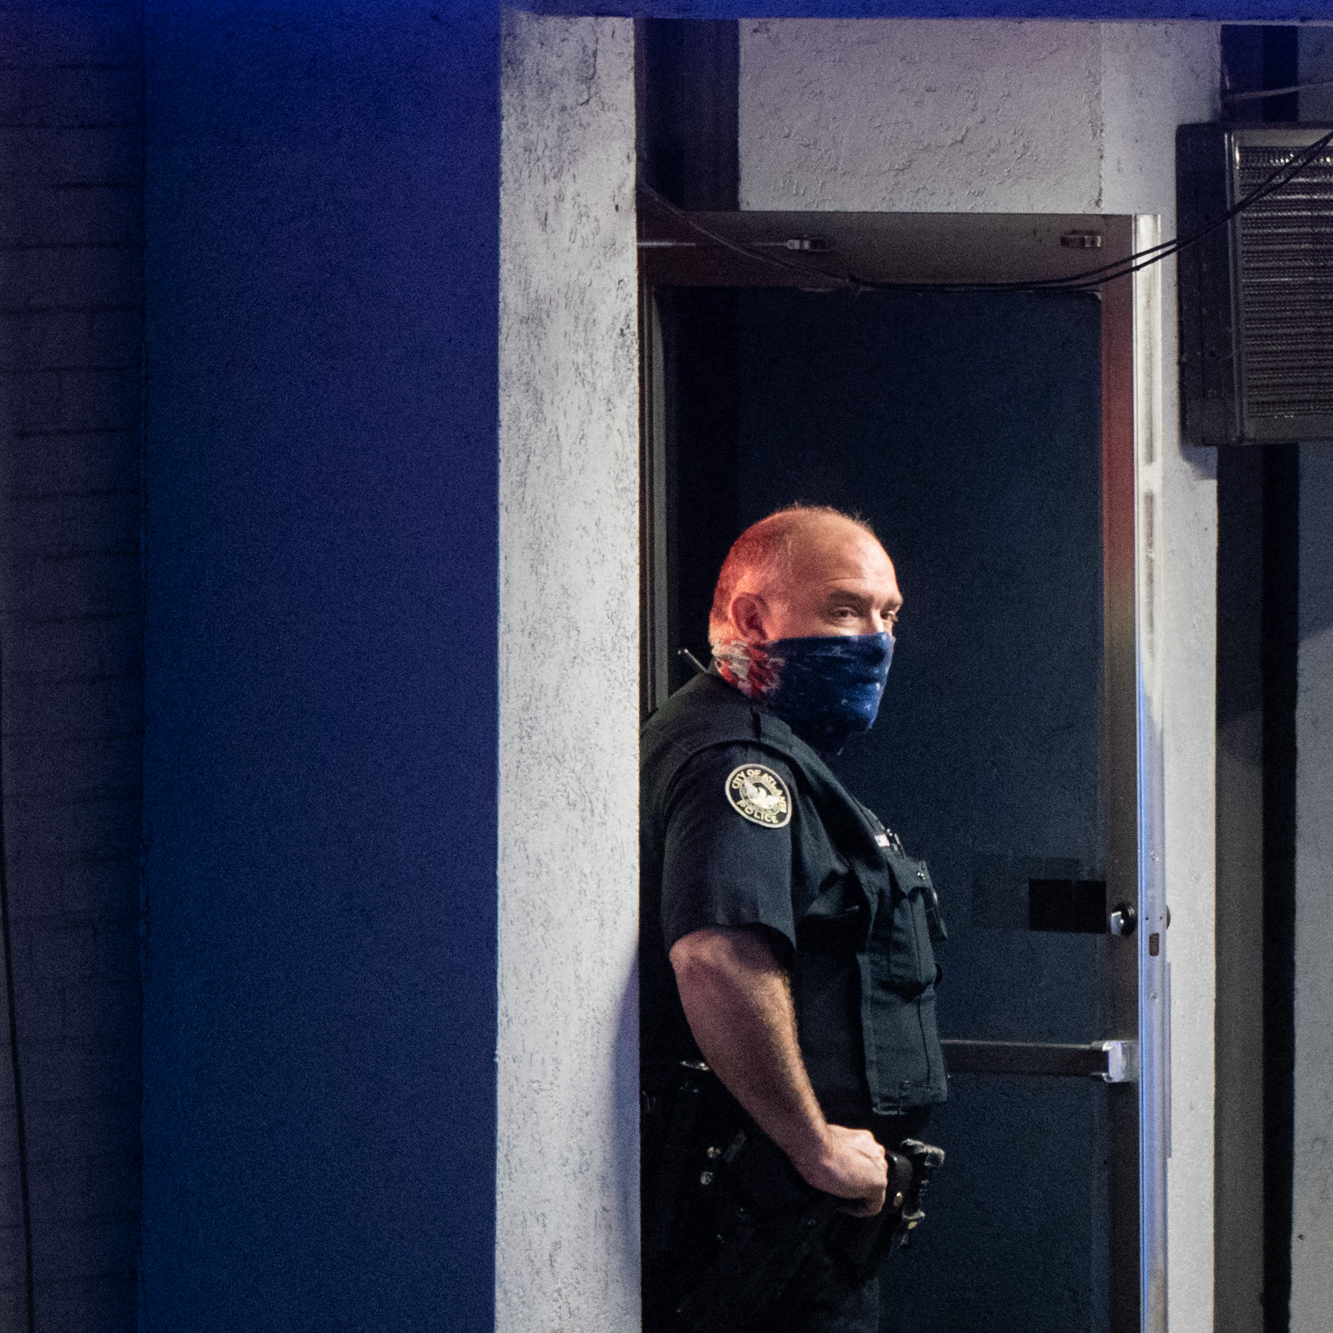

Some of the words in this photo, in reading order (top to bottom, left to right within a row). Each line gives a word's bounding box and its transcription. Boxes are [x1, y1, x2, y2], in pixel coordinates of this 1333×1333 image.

[731, 771, 746, 789] CITY
[746, 769, 762, 777] OF
[737, 800, 779, 824] POLICE
